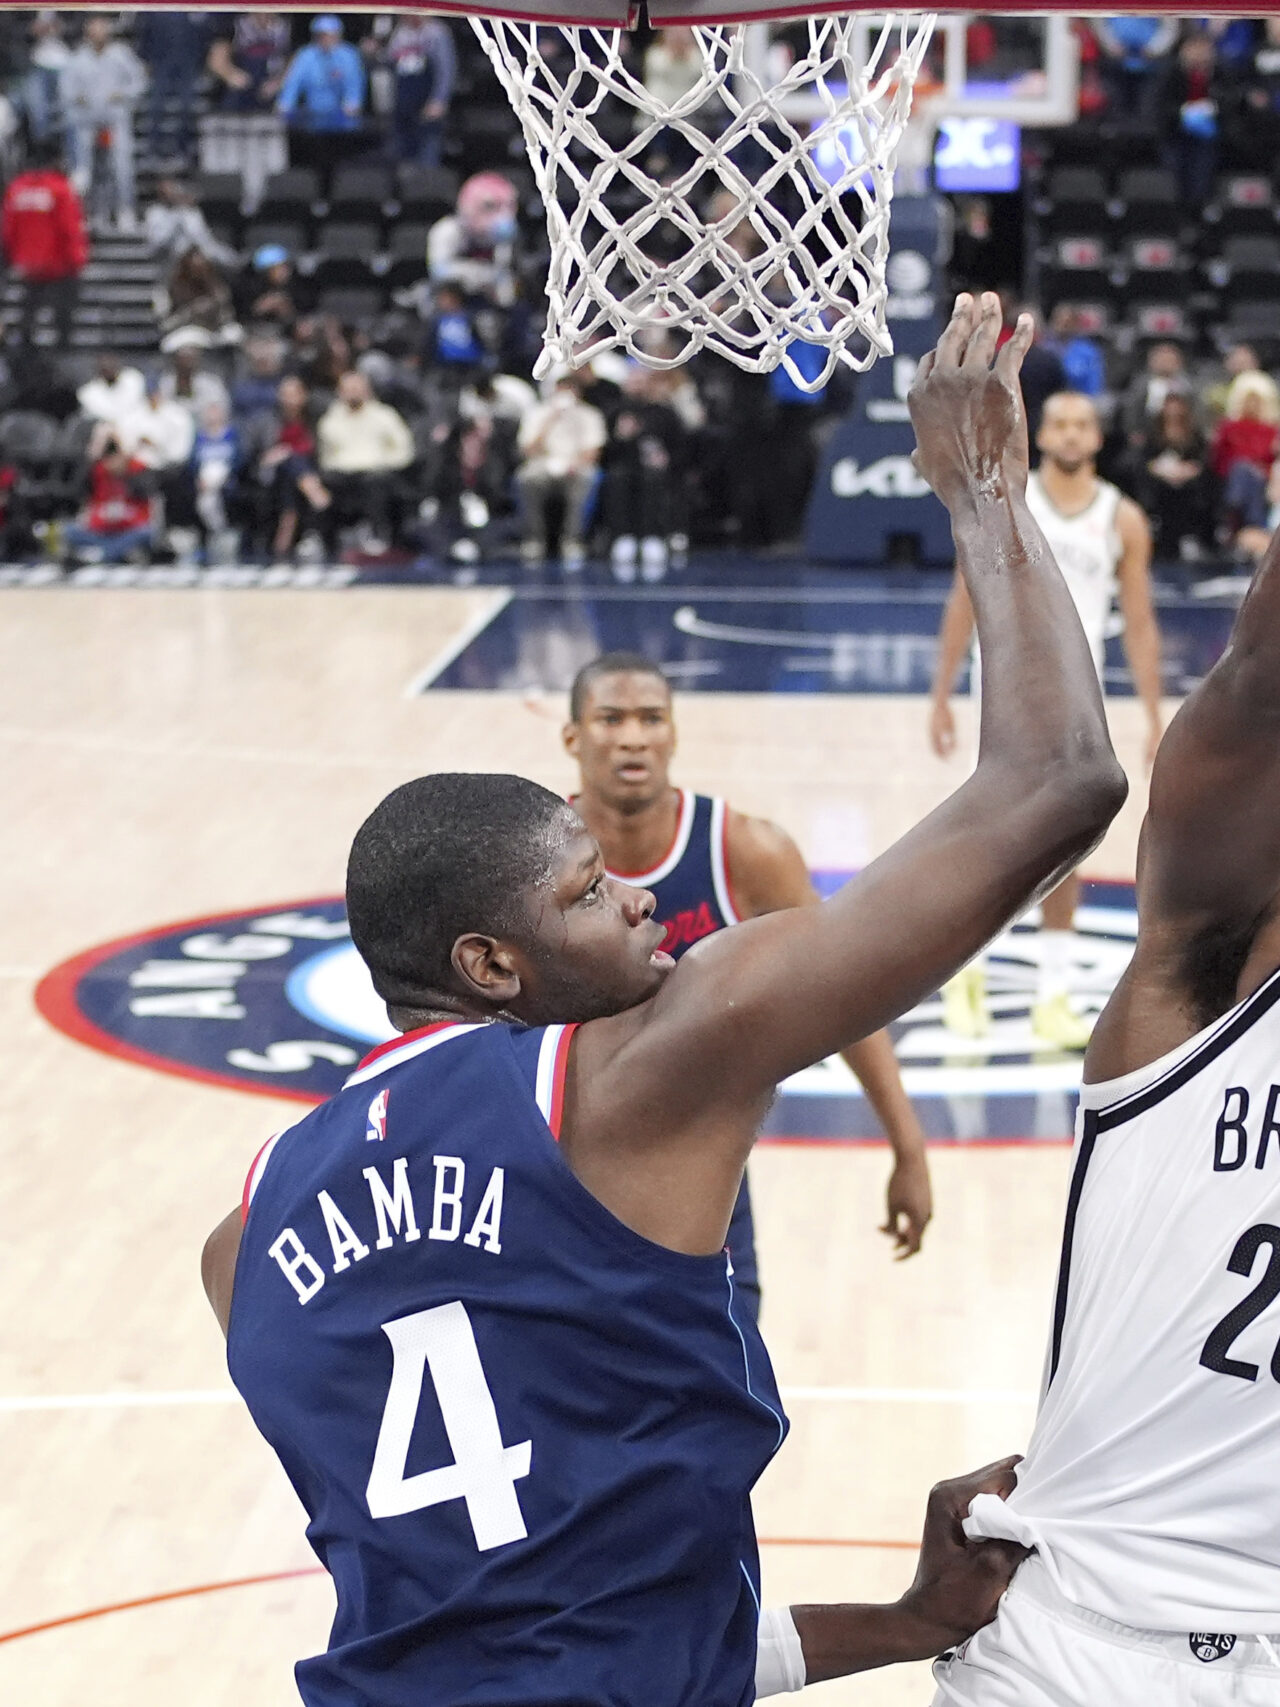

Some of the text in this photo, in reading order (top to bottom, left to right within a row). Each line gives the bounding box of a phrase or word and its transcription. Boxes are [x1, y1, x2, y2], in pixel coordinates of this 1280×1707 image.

[129, 912, 350, 1019] ANGE
[268, 1155, 506, 1306] BAMBA
[365, 1301, 532, 1551] 4
